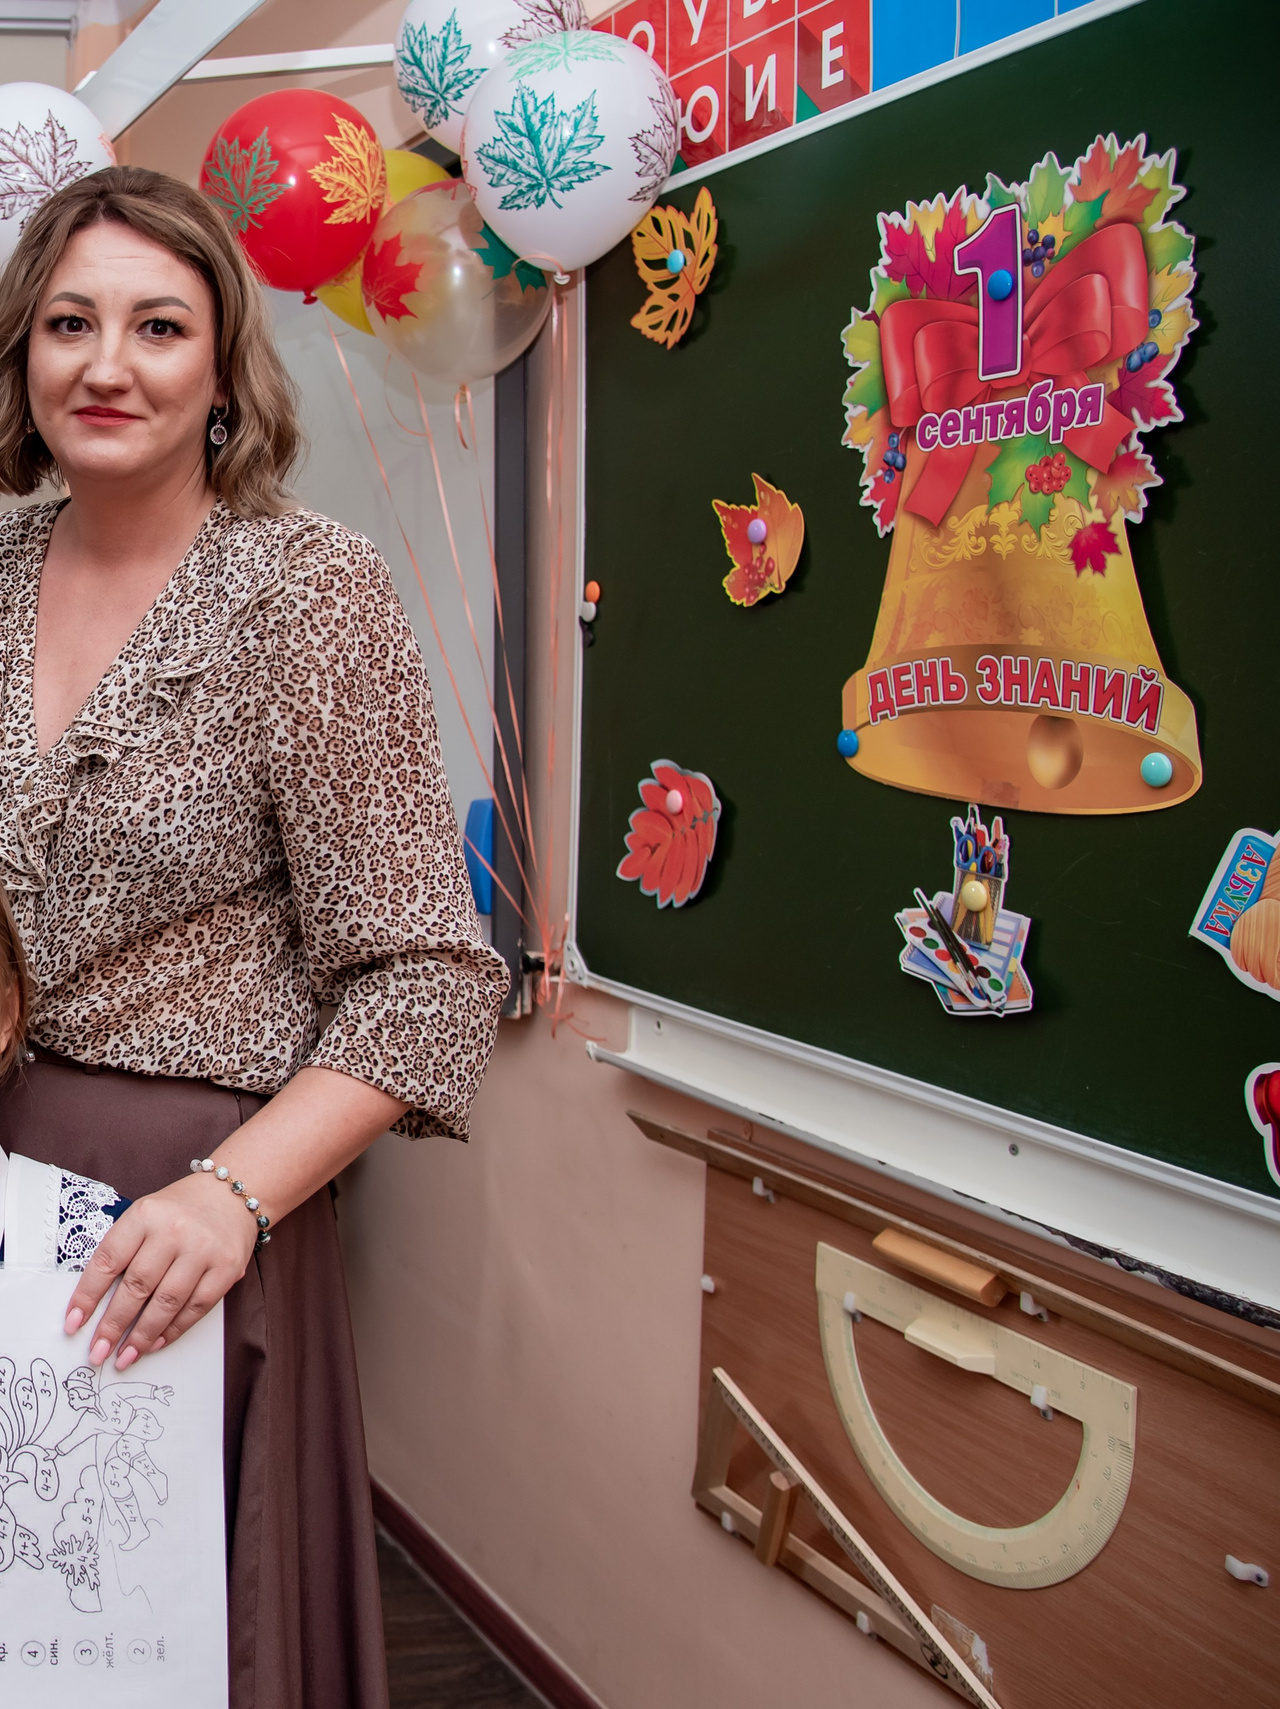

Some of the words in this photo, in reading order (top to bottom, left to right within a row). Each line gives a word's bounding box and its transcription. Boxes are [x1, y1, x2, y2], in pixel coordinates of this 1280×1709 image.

[676, 84, 720, 151] Ю
[744, 53, 777, 122] И
[821, 21, 845, 90] Е
[954, 205, 1022, 380] 1
[917, 379, 1105, 451] сентября
[867, 657, 968, 725] ДЕНЬ
[976, 655, 1164, 735] ЗНАНИЙ
[1204, 843, 1267, 937] АЗБУКА
[40, 1371, 51, 1397] 3-1
[22, 1385, 32, 1410] 5-2
[111, 1400, 121, 1424] 3+2
[143, 1414, 152, 1435] 1+4
[121, 1439, 131, 1458] 3+1
[110, 1465, 120, 1488] 5-1
[137, 1457, 156, 1477] 2+1
[41, 1469, 51, 1491] 4-2
[82, 1497, 95, 1524] 5-3
[125, 1503, 137, 1522] 4-1
[19, 1532, 31, 1556] 1+3
[27, 1650, 39, 1658] 4
[50, 1639, 58, 1666] син.
[80, 1648, 92, 1656] 3
[103, 1632, 114, 1668] жёлт.
[156, 1636, 165, 1662] зел.
